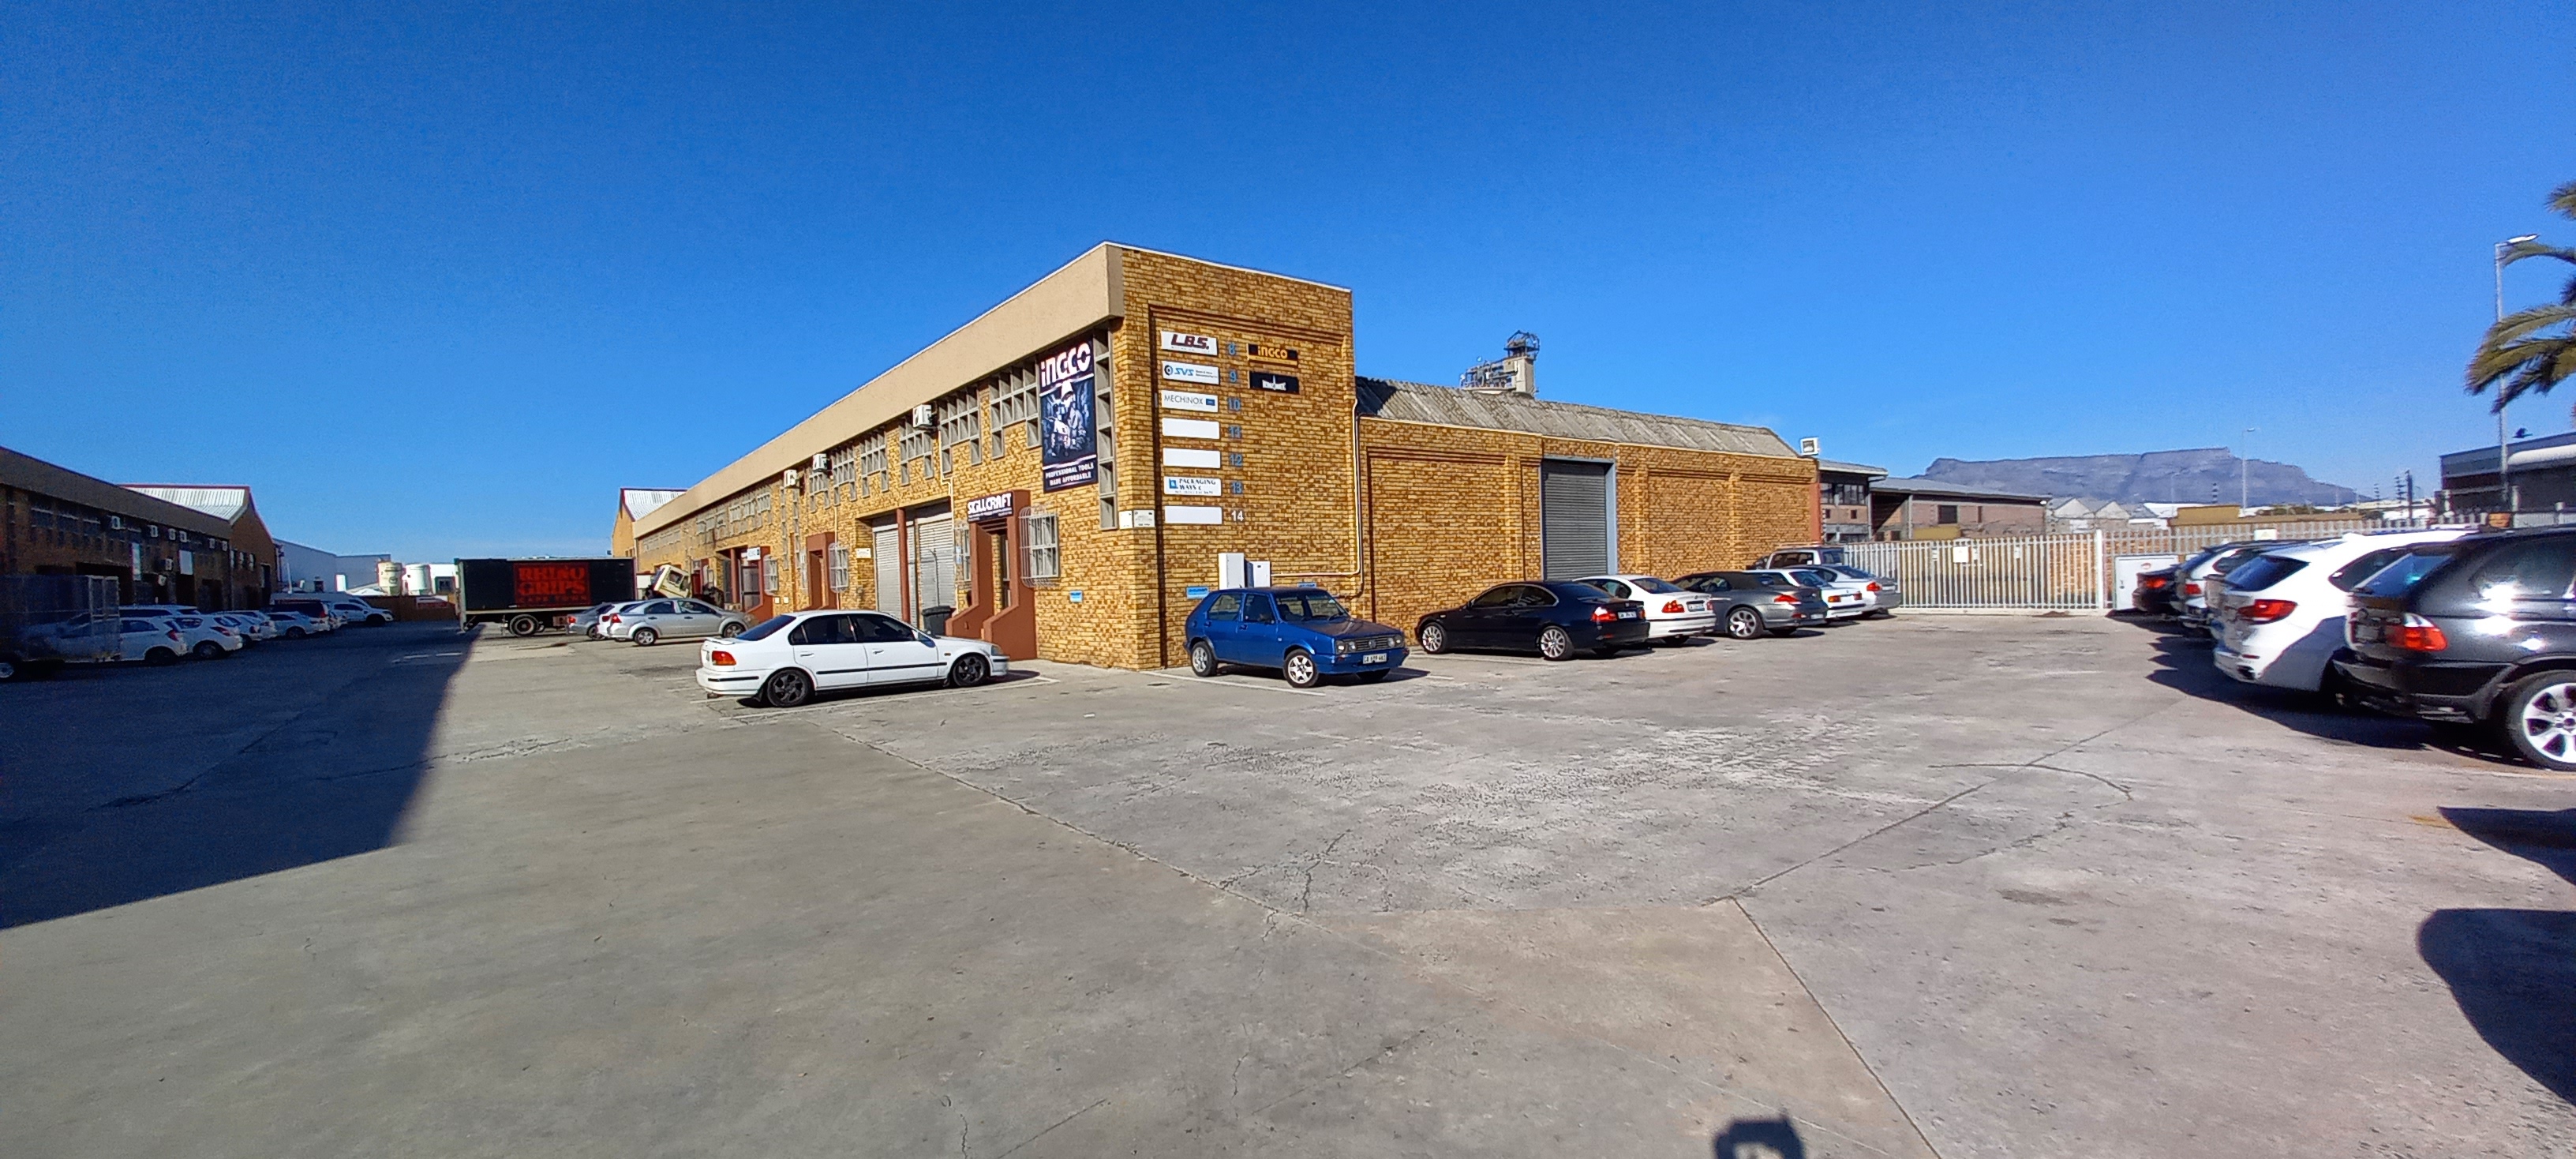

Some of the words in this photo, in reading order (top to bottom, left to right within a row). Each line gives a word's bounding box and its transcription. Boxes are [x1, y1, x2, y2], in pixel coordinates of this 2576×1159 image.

[1228, 342, 1236, 355] 8
[1229, 370, 1237, 383] 9
[1228, 398, 1241, 411] 10
[1230, 453, 1243, 467] 12
[1231, 509, 1244, 521] 14
[519, 567, 586, 580] RHINO
